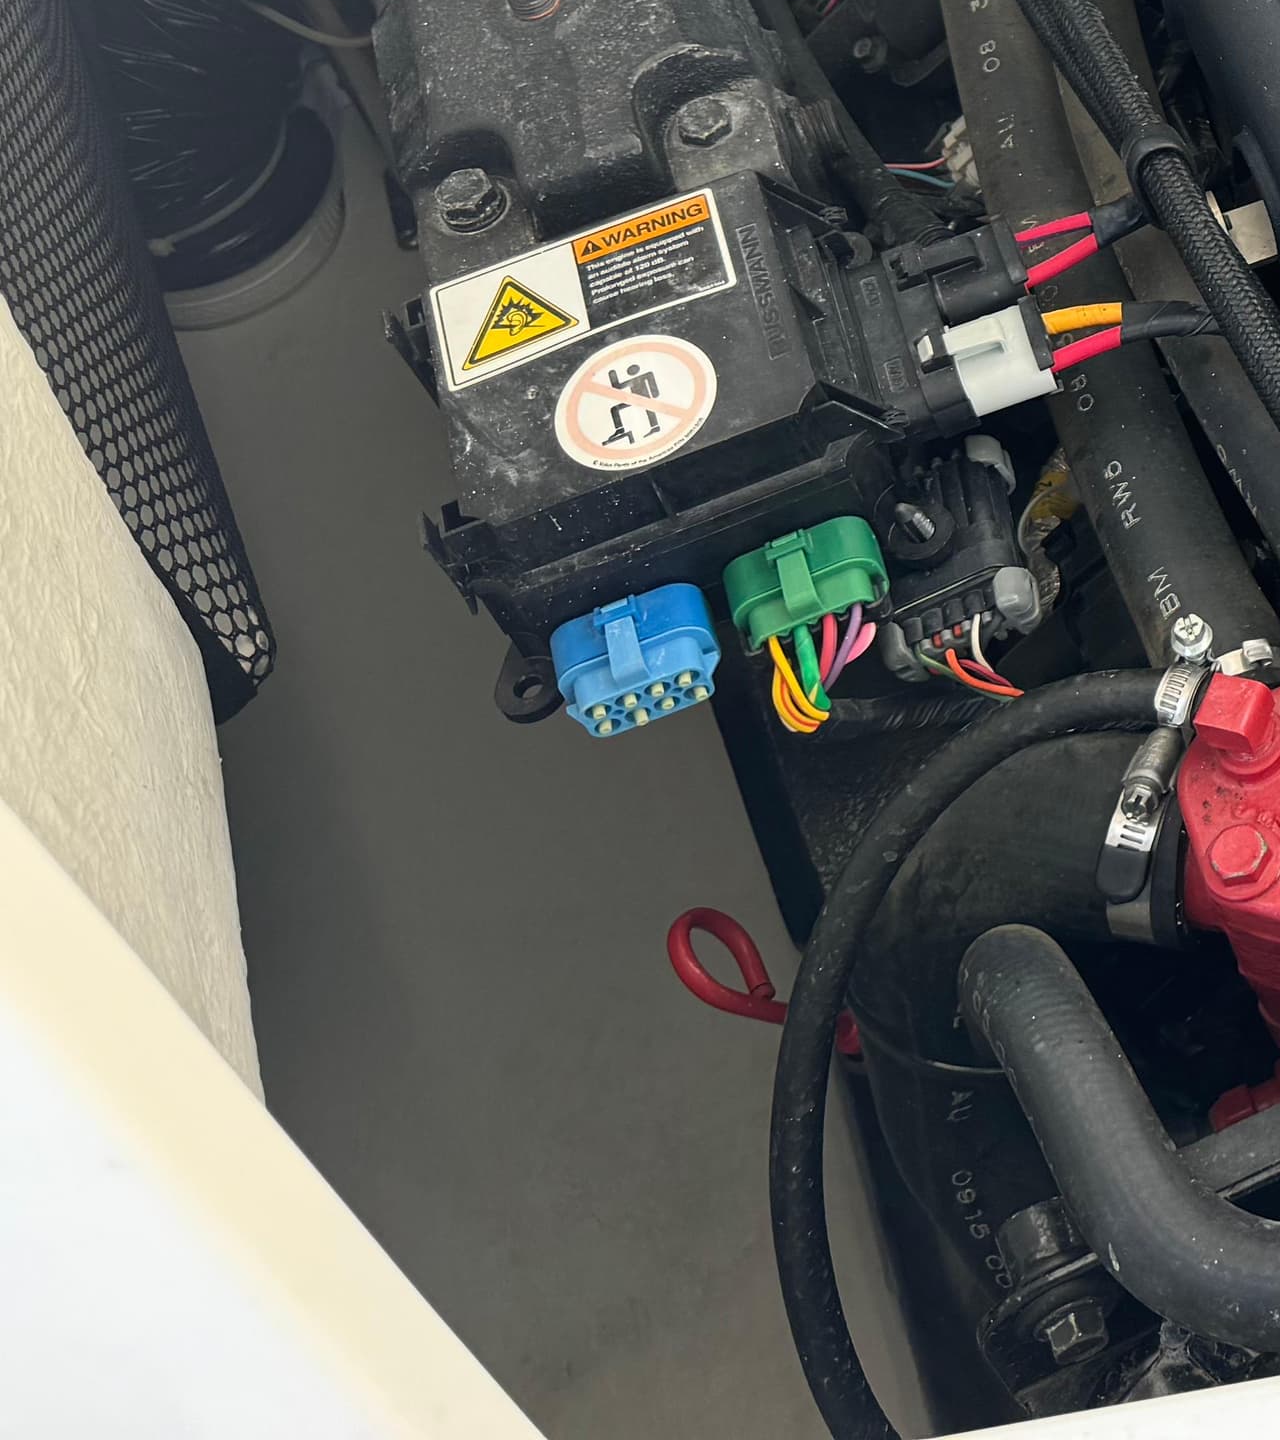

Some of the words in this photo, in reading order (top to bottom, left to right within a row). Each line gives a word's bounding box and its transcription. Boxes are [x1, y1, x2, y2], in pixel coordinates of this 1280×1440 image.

[600, 202, 703, 248] WARNING
[586, 260, 605, 271] This
[605, 249, 635, 265] engine
[644, 231, 685, 251] equipped
[599, 259, 631, 275] audible
[632, 250, 656, 263] alarm
[657, 239, 689, 255] system
[588, 271, 623, 288] capable
[590, 275, 635, 296] Prolonged
[635, 261, 676, 280] exposure
[592, 290, 619, 304] cause
[619, 278, 653, 294] hearing
[1144, 564, 1184, 619] BM
